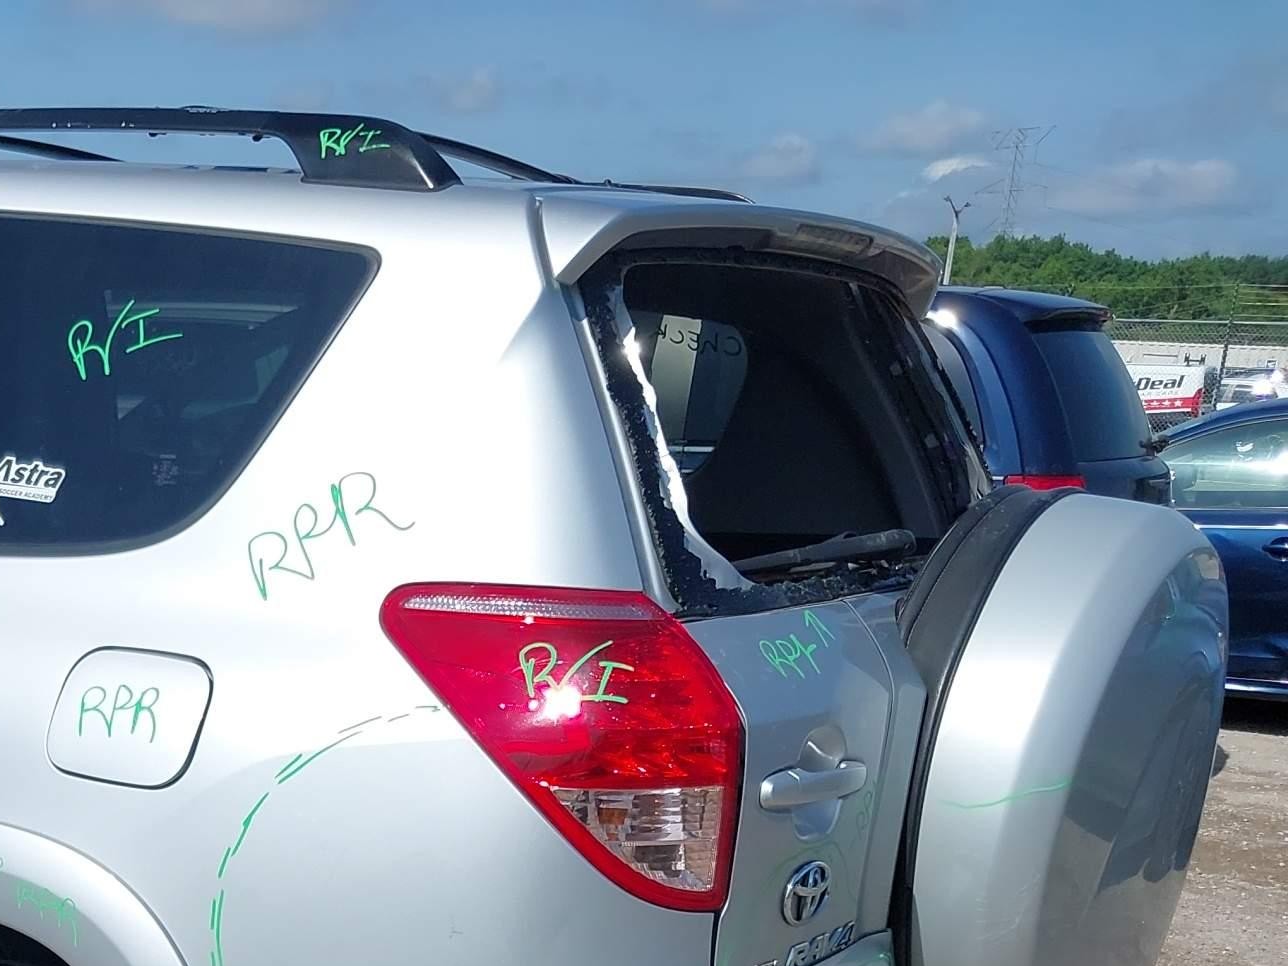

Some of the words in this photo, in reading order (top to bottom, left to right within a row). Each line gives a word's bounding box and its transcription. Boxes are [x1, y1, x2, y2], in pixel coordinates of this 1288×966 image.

[319, 123, 391, 159] R/I
[68, 299, 183, 381] R/I
[519, 640, 635, 704] R/I
[79, 685, 160, 743] RPR
